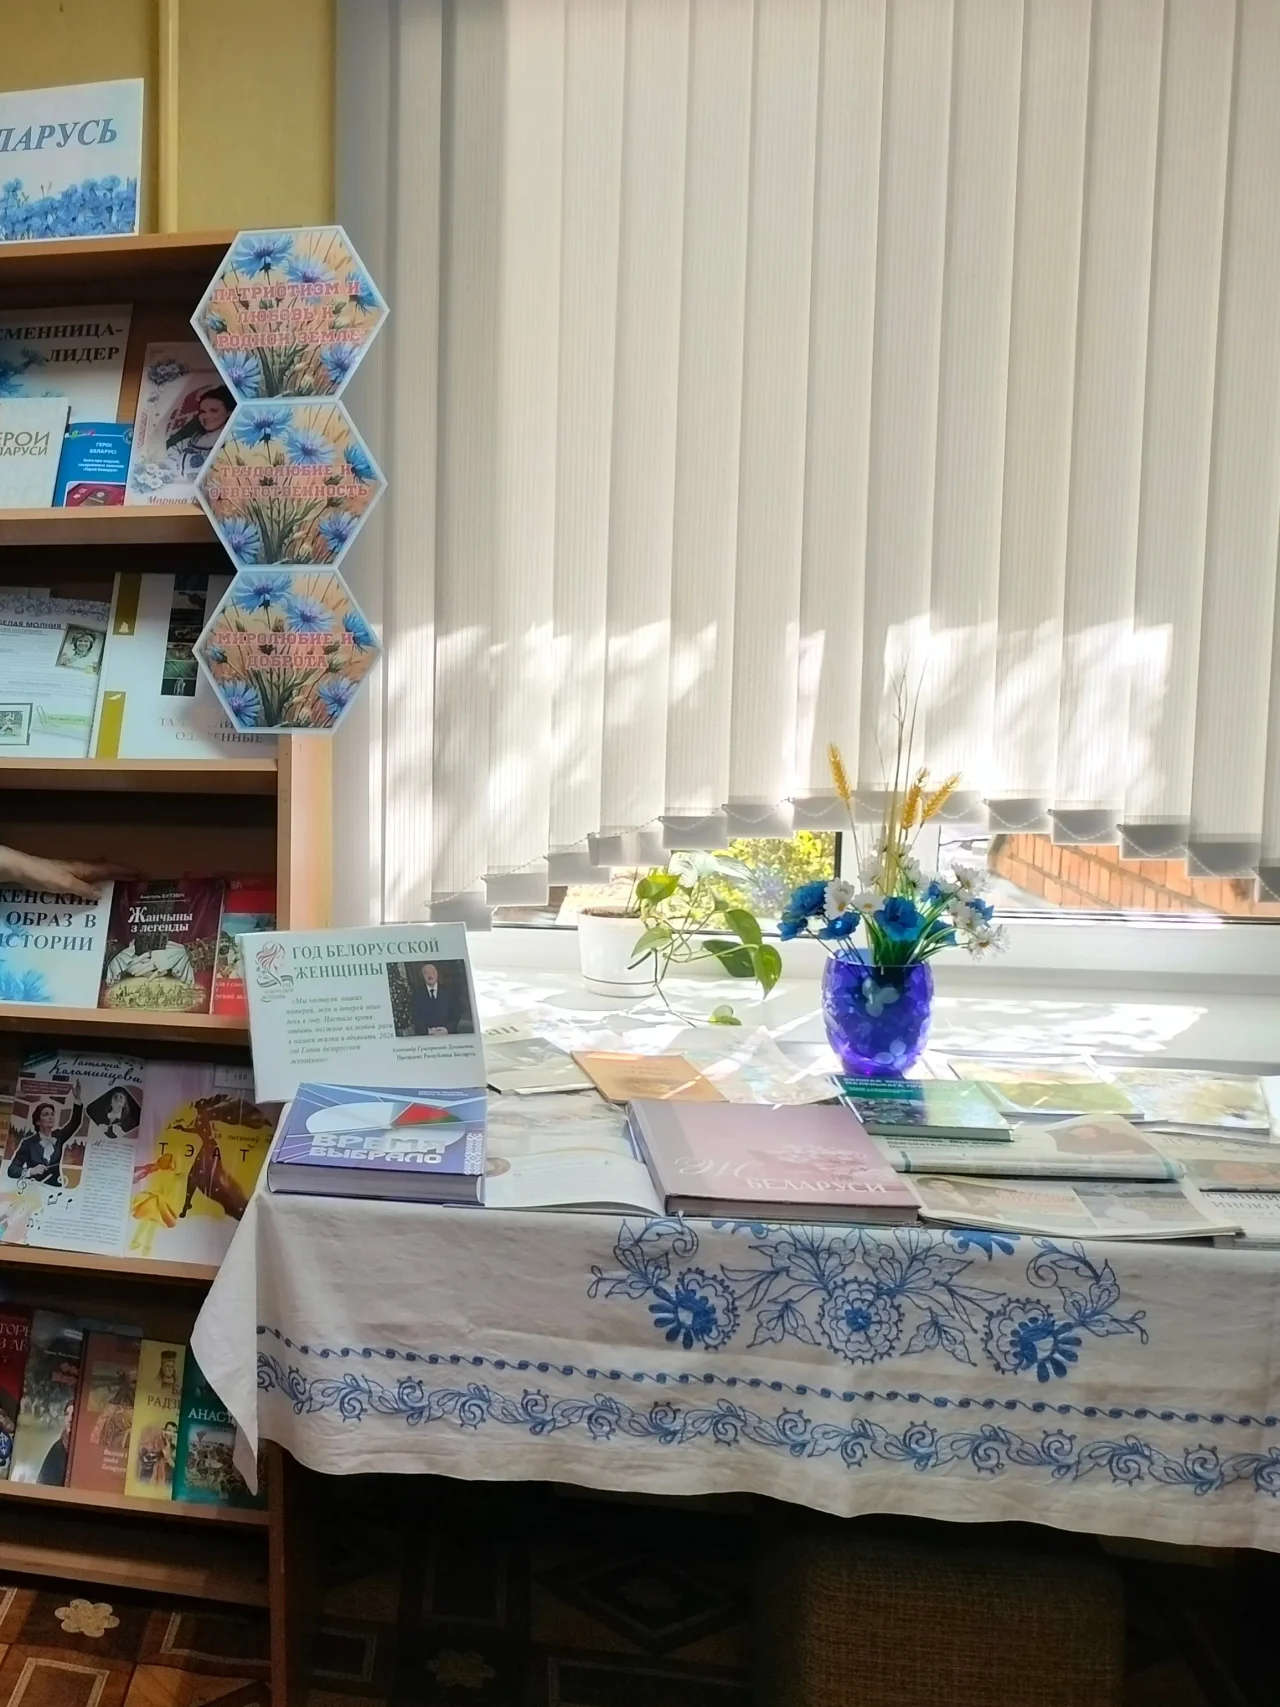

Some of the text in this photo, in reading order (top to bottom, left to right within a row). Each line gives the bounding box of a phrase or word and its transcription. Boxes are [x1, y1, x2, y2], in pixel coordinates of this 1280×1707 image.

[213, 281, 360, 301] ПАТРИОТИЗМ И
[238, 307, 335, 323] ЛЮБОВЬ К
[298, 329, 361, 344] ЗЕМЛЕ
[45, 347, 120, 364] ЛИДЕР
[220, 464, 352, 478] ТРУДОЛЮБИЕ И
[209, 485, 369, 499] ОТВЕТСТВЕННОСТЬ
[26, 622, 61, 630] МОЛНИЯ
[216, 632, 354, 646] МИРОЛЮБИЕ И
[247, 654, 328, 670] ДОБРОТА
[6, 911, 97, 928] ОБРАЗ В
[127, 906, 193, 923] Жанчыны
[131, 923, 189, 932] з легенды
[292, 938, 440, 960] ГОД БЕЛОРУССКОЙ
[295, 962, 384, 981] ЖЕНЩИНЫ
[312, 1134, 446, 1154] ВРЕМЯ
[309, 1149, 442, 1165] ВЫБРАЛО
[747, 1177, 888, 1194] БЕЛАРУСИ
